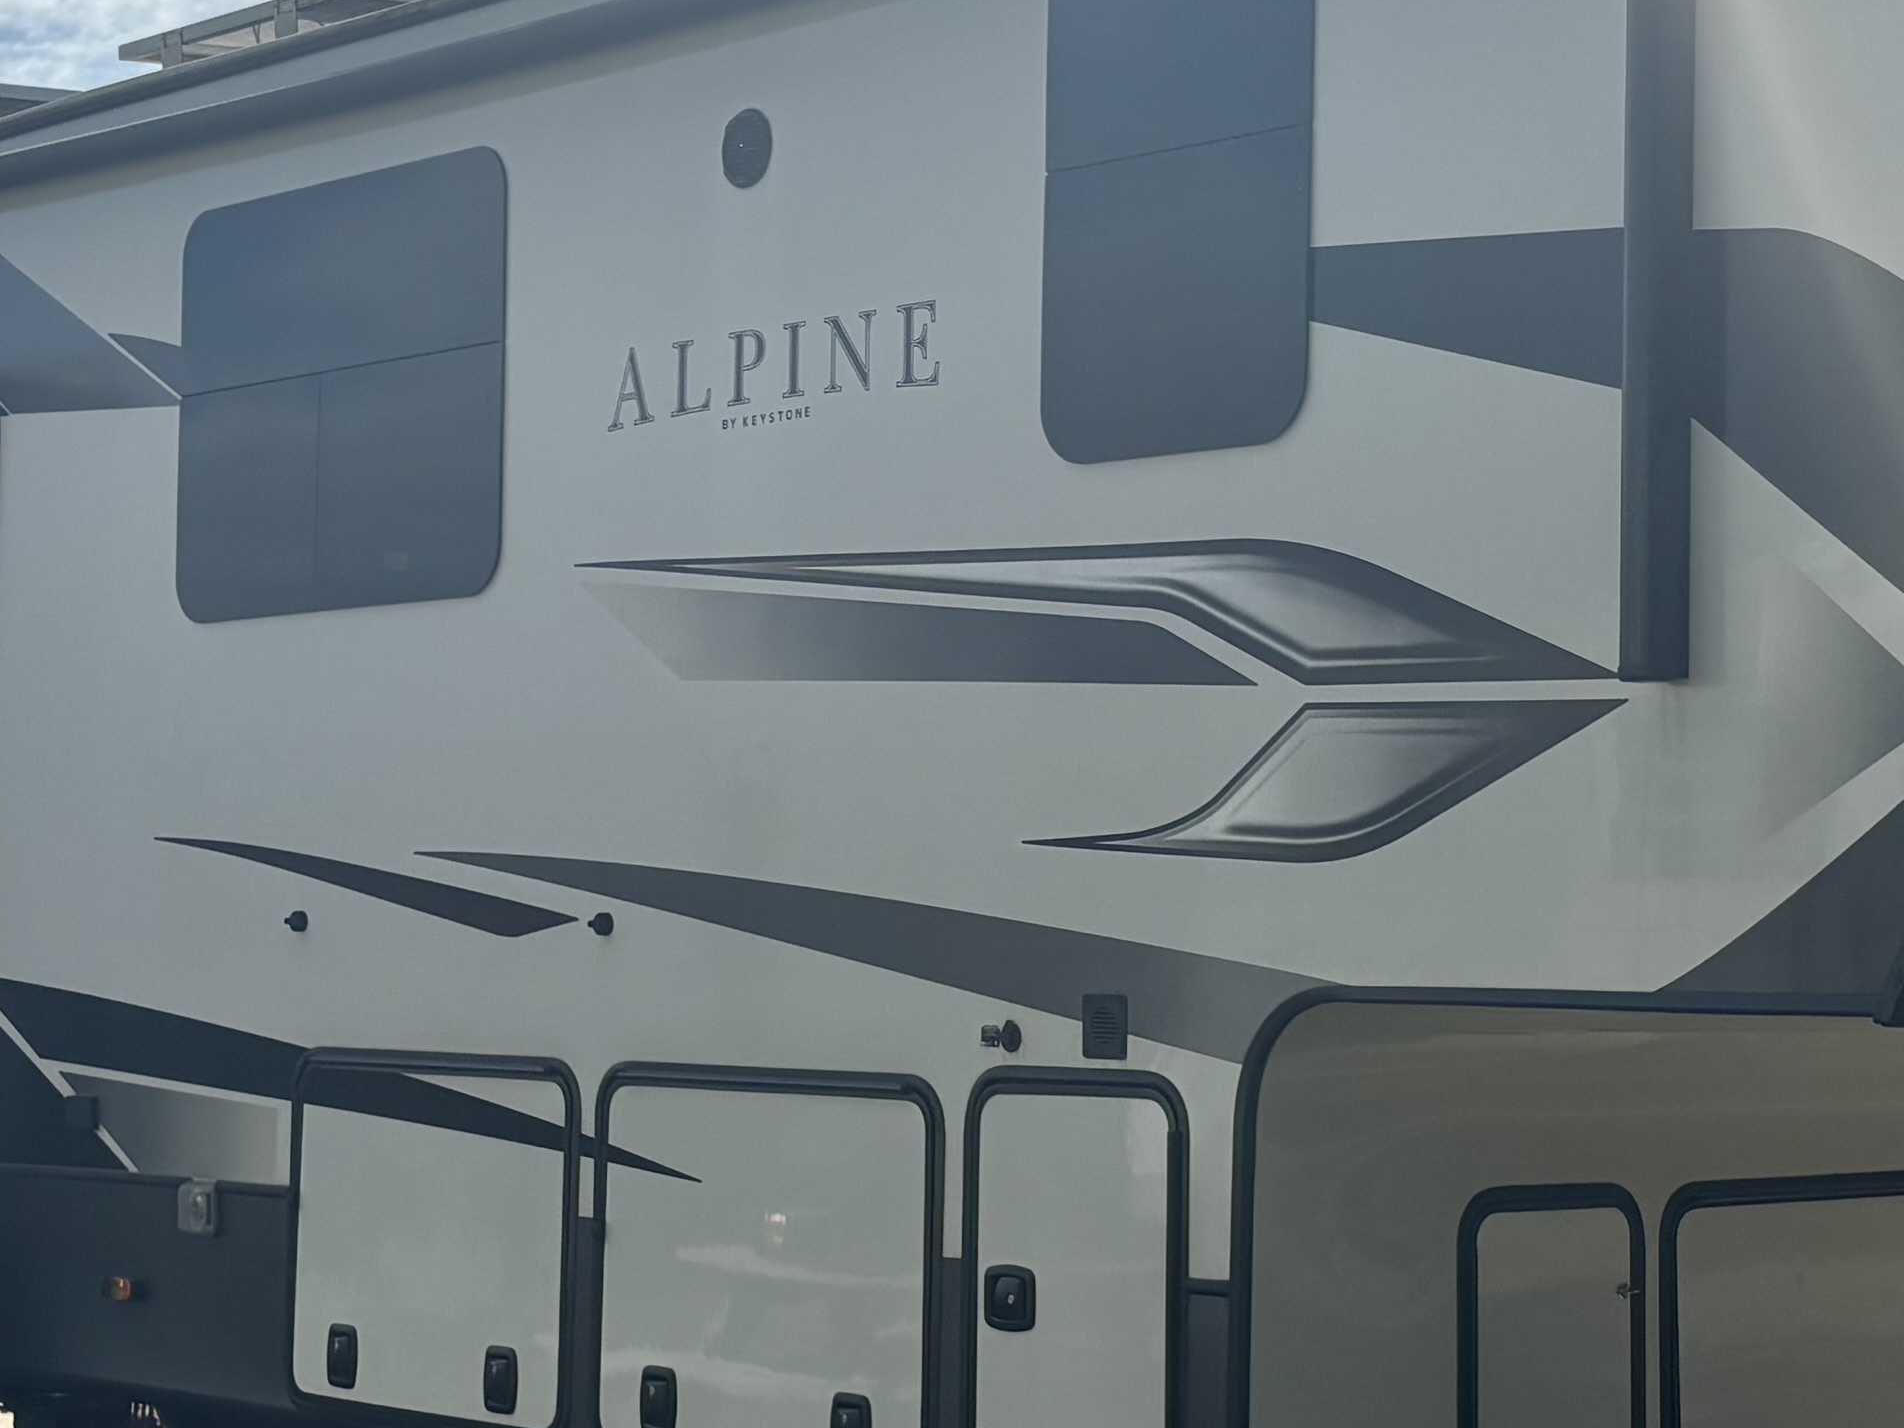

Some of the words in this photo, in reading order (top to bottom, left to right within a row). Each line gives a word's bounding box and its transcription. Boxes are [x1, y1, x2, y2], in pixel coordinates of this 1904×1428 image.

[607, 299, 940, 432] ALPINE
[722, 417, 737, 430] BY
[742, 406, 811, 427] KEYSTONE
